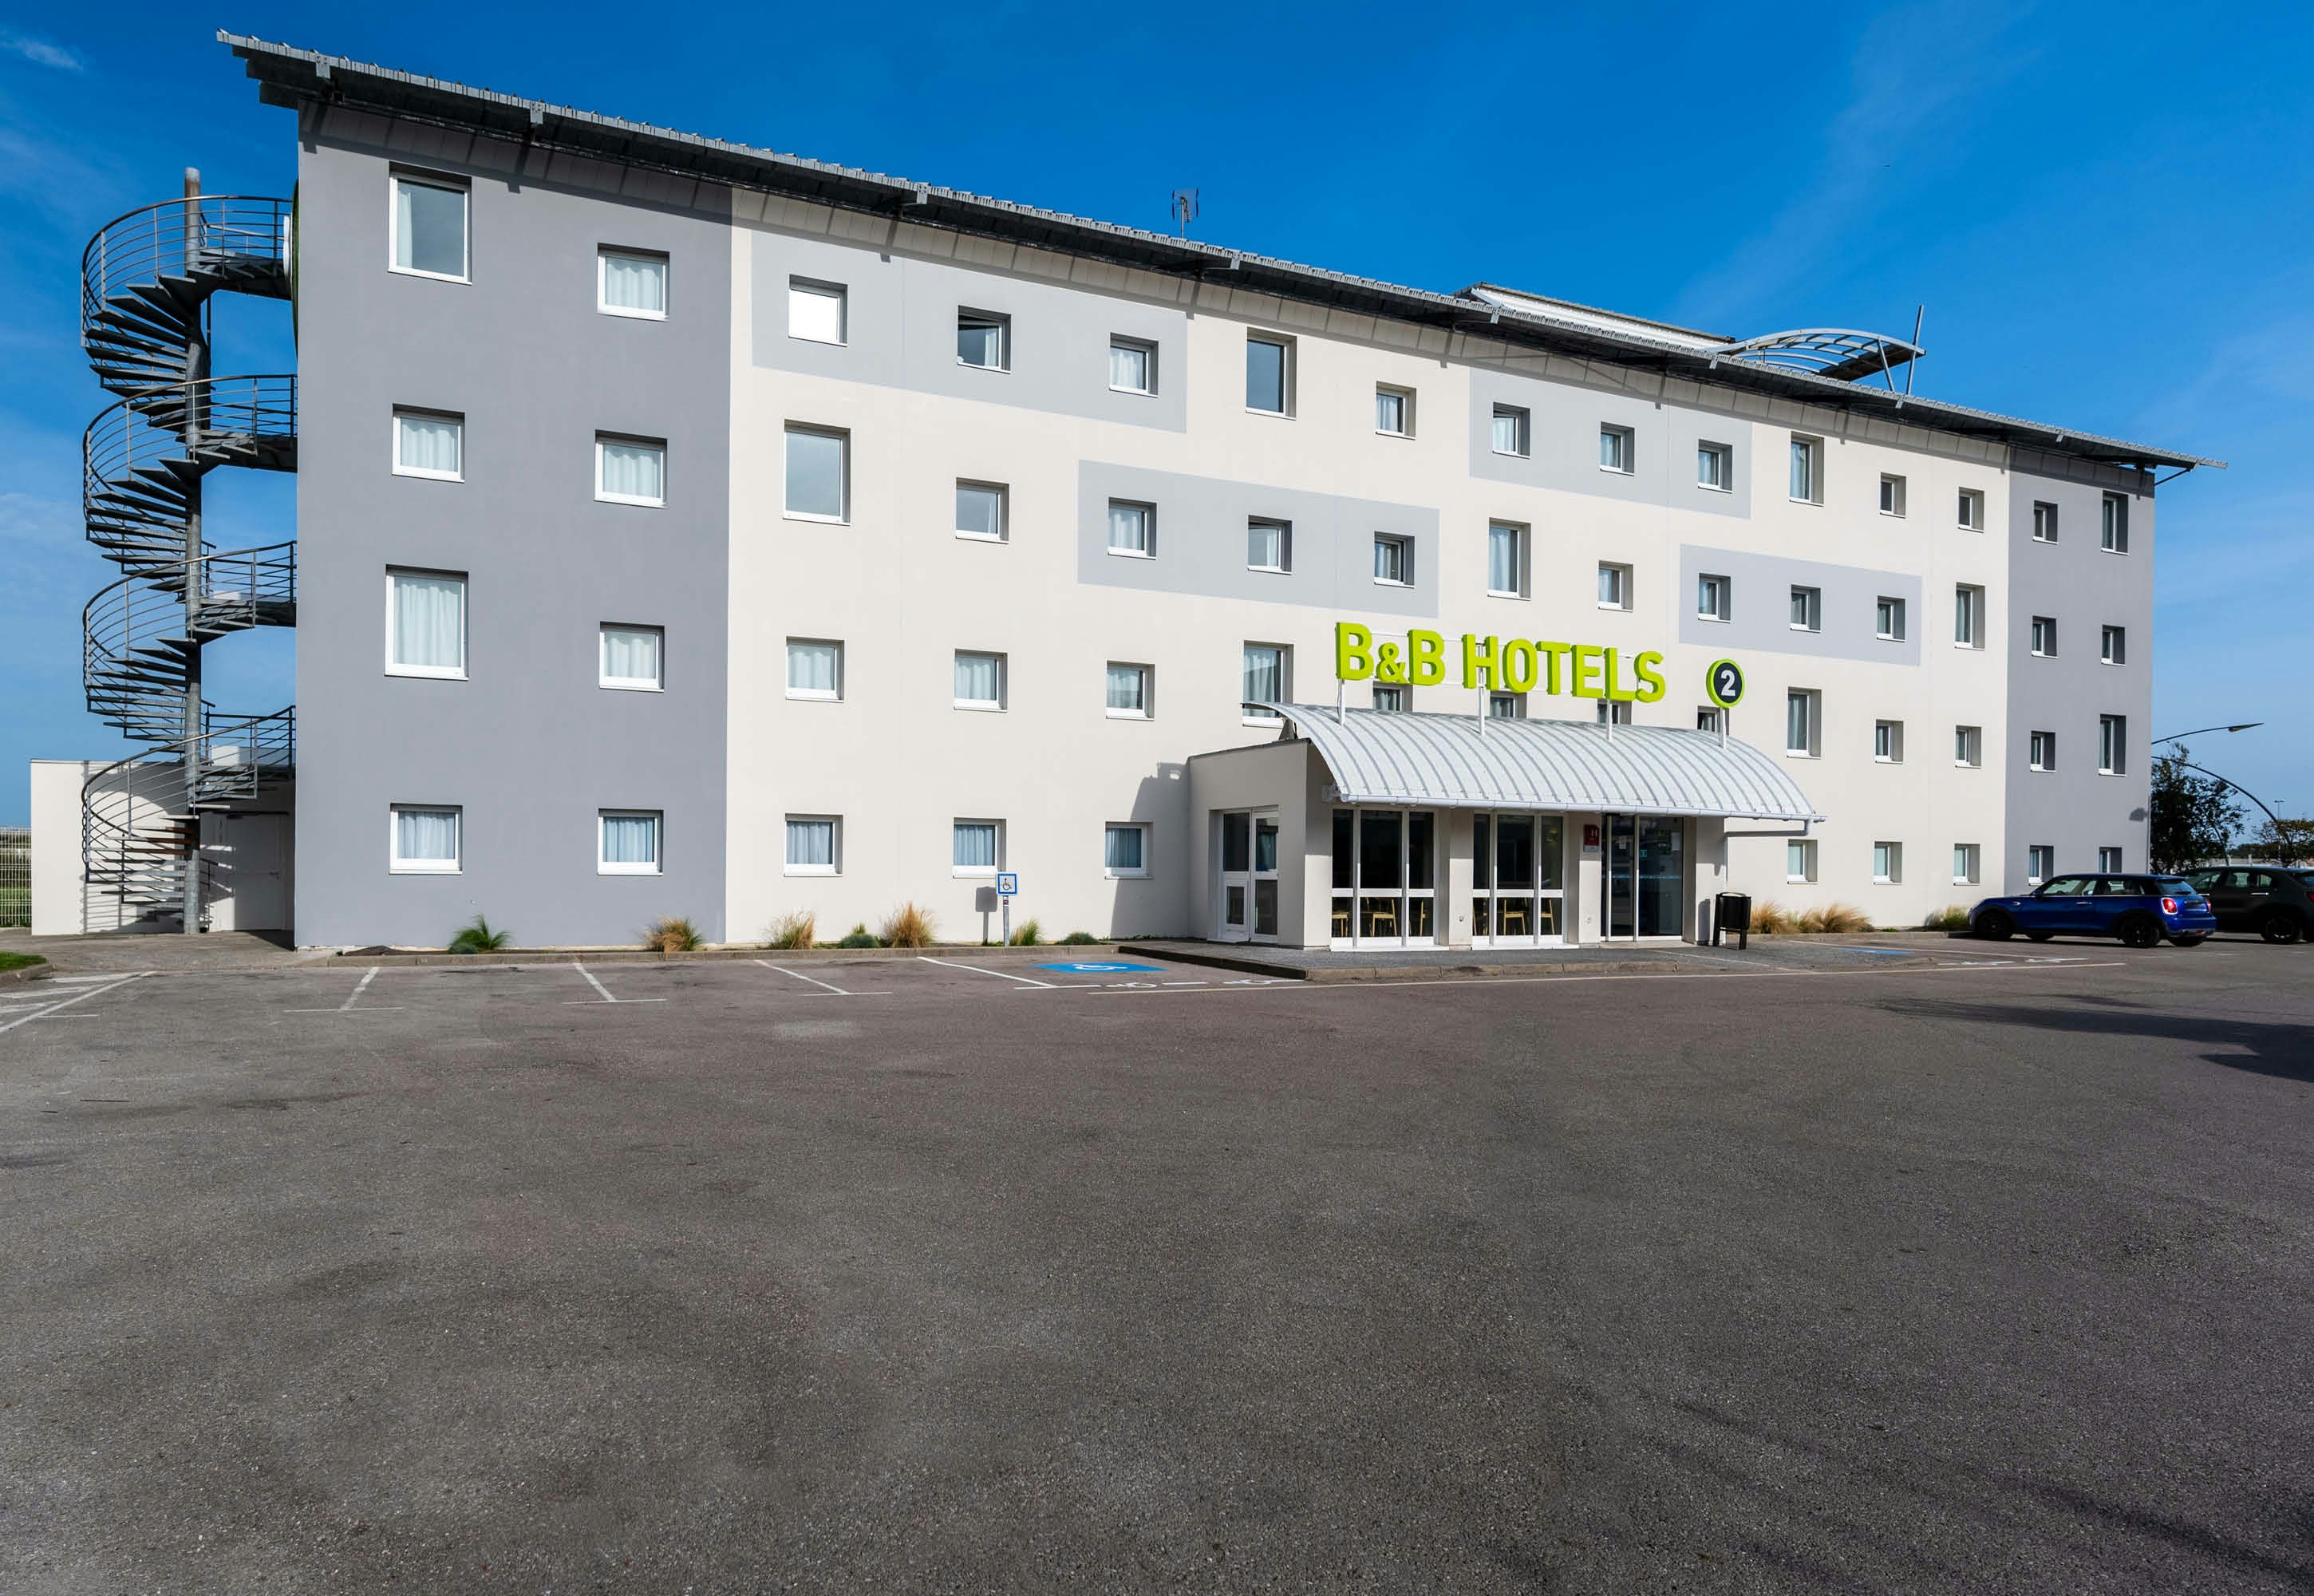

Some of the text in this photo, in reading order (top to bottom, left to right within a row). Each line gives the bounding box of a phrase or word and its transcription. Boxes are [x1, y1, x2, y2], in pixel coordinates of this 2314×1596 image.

[1336, 622, 1666, 703] B&B HOTELS
[1720, 670, 1736, 696] 2
